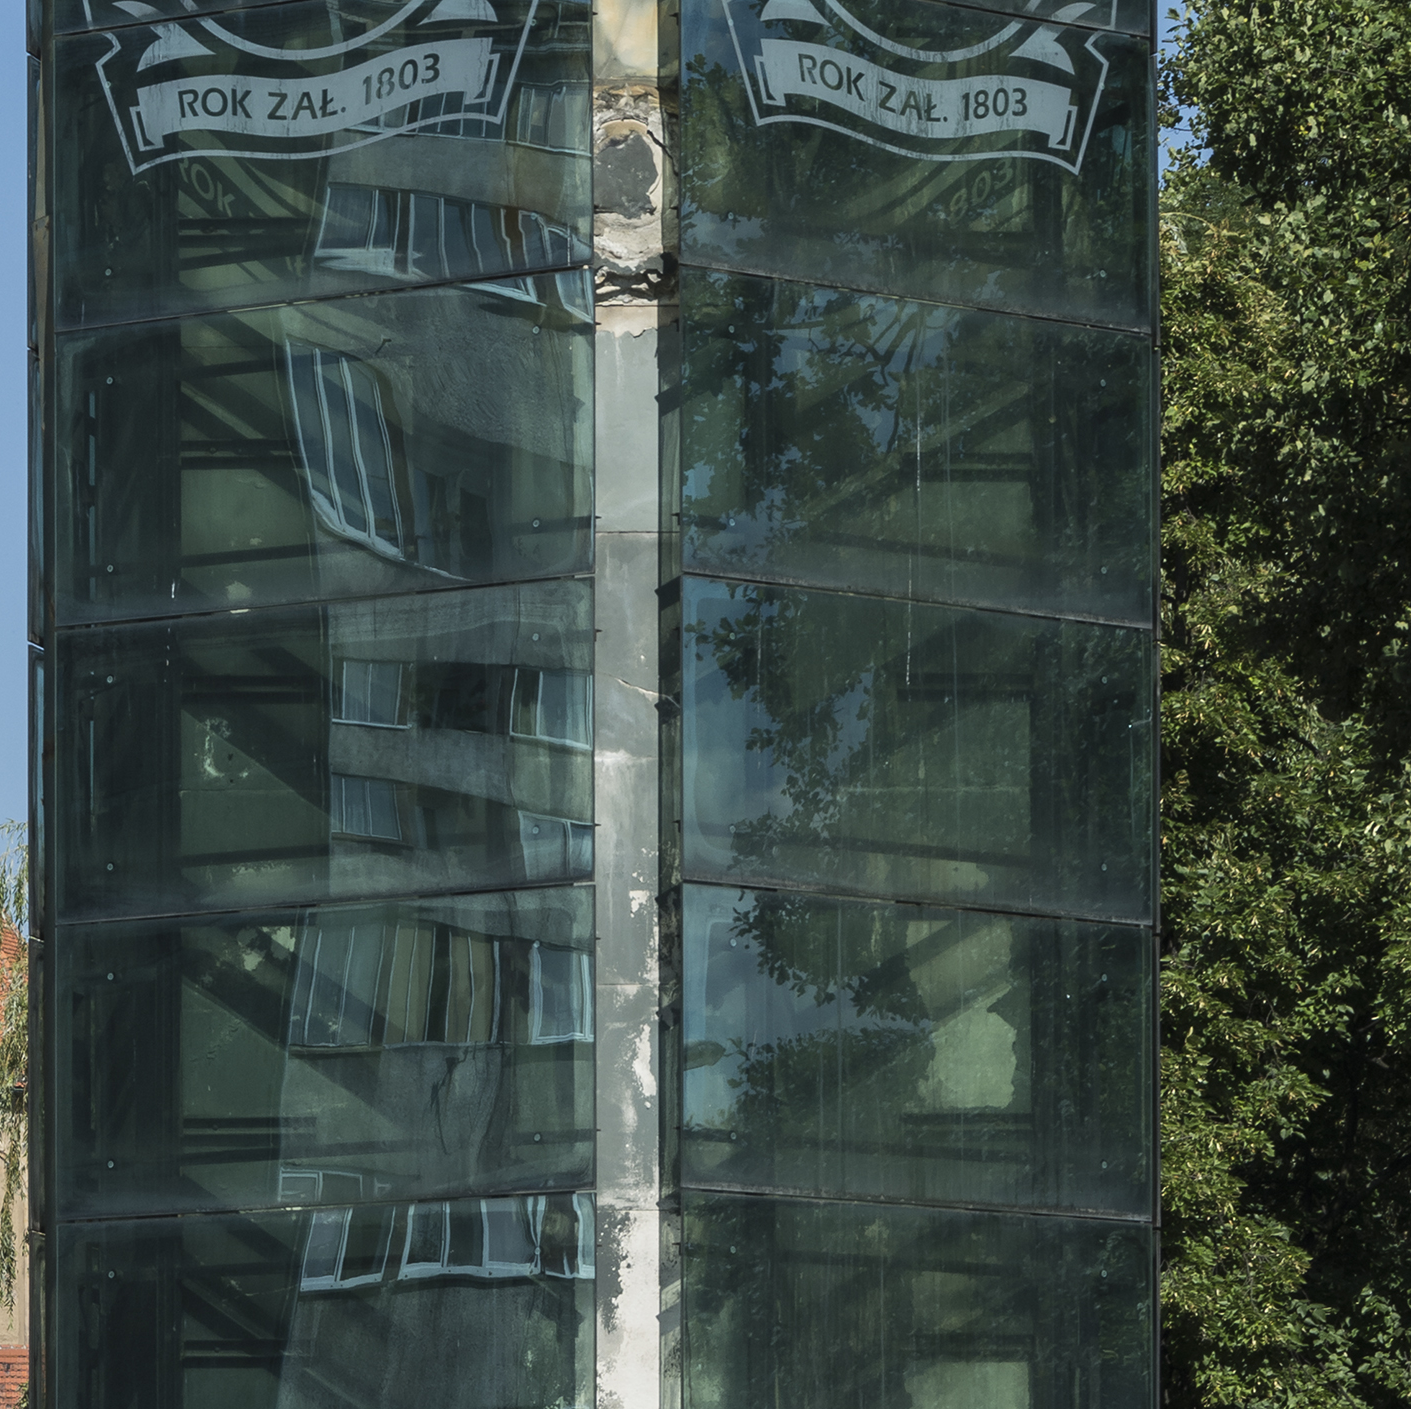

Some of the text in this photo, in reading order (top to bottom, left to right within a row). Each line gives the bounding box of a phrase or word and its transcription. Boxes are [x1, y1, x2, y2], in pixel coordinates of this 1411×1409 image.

[178, 53, 441, 122] ROK ZAŁ. 1803
[797, 53, 1028, 124] ROK ZAŁ. 1803
